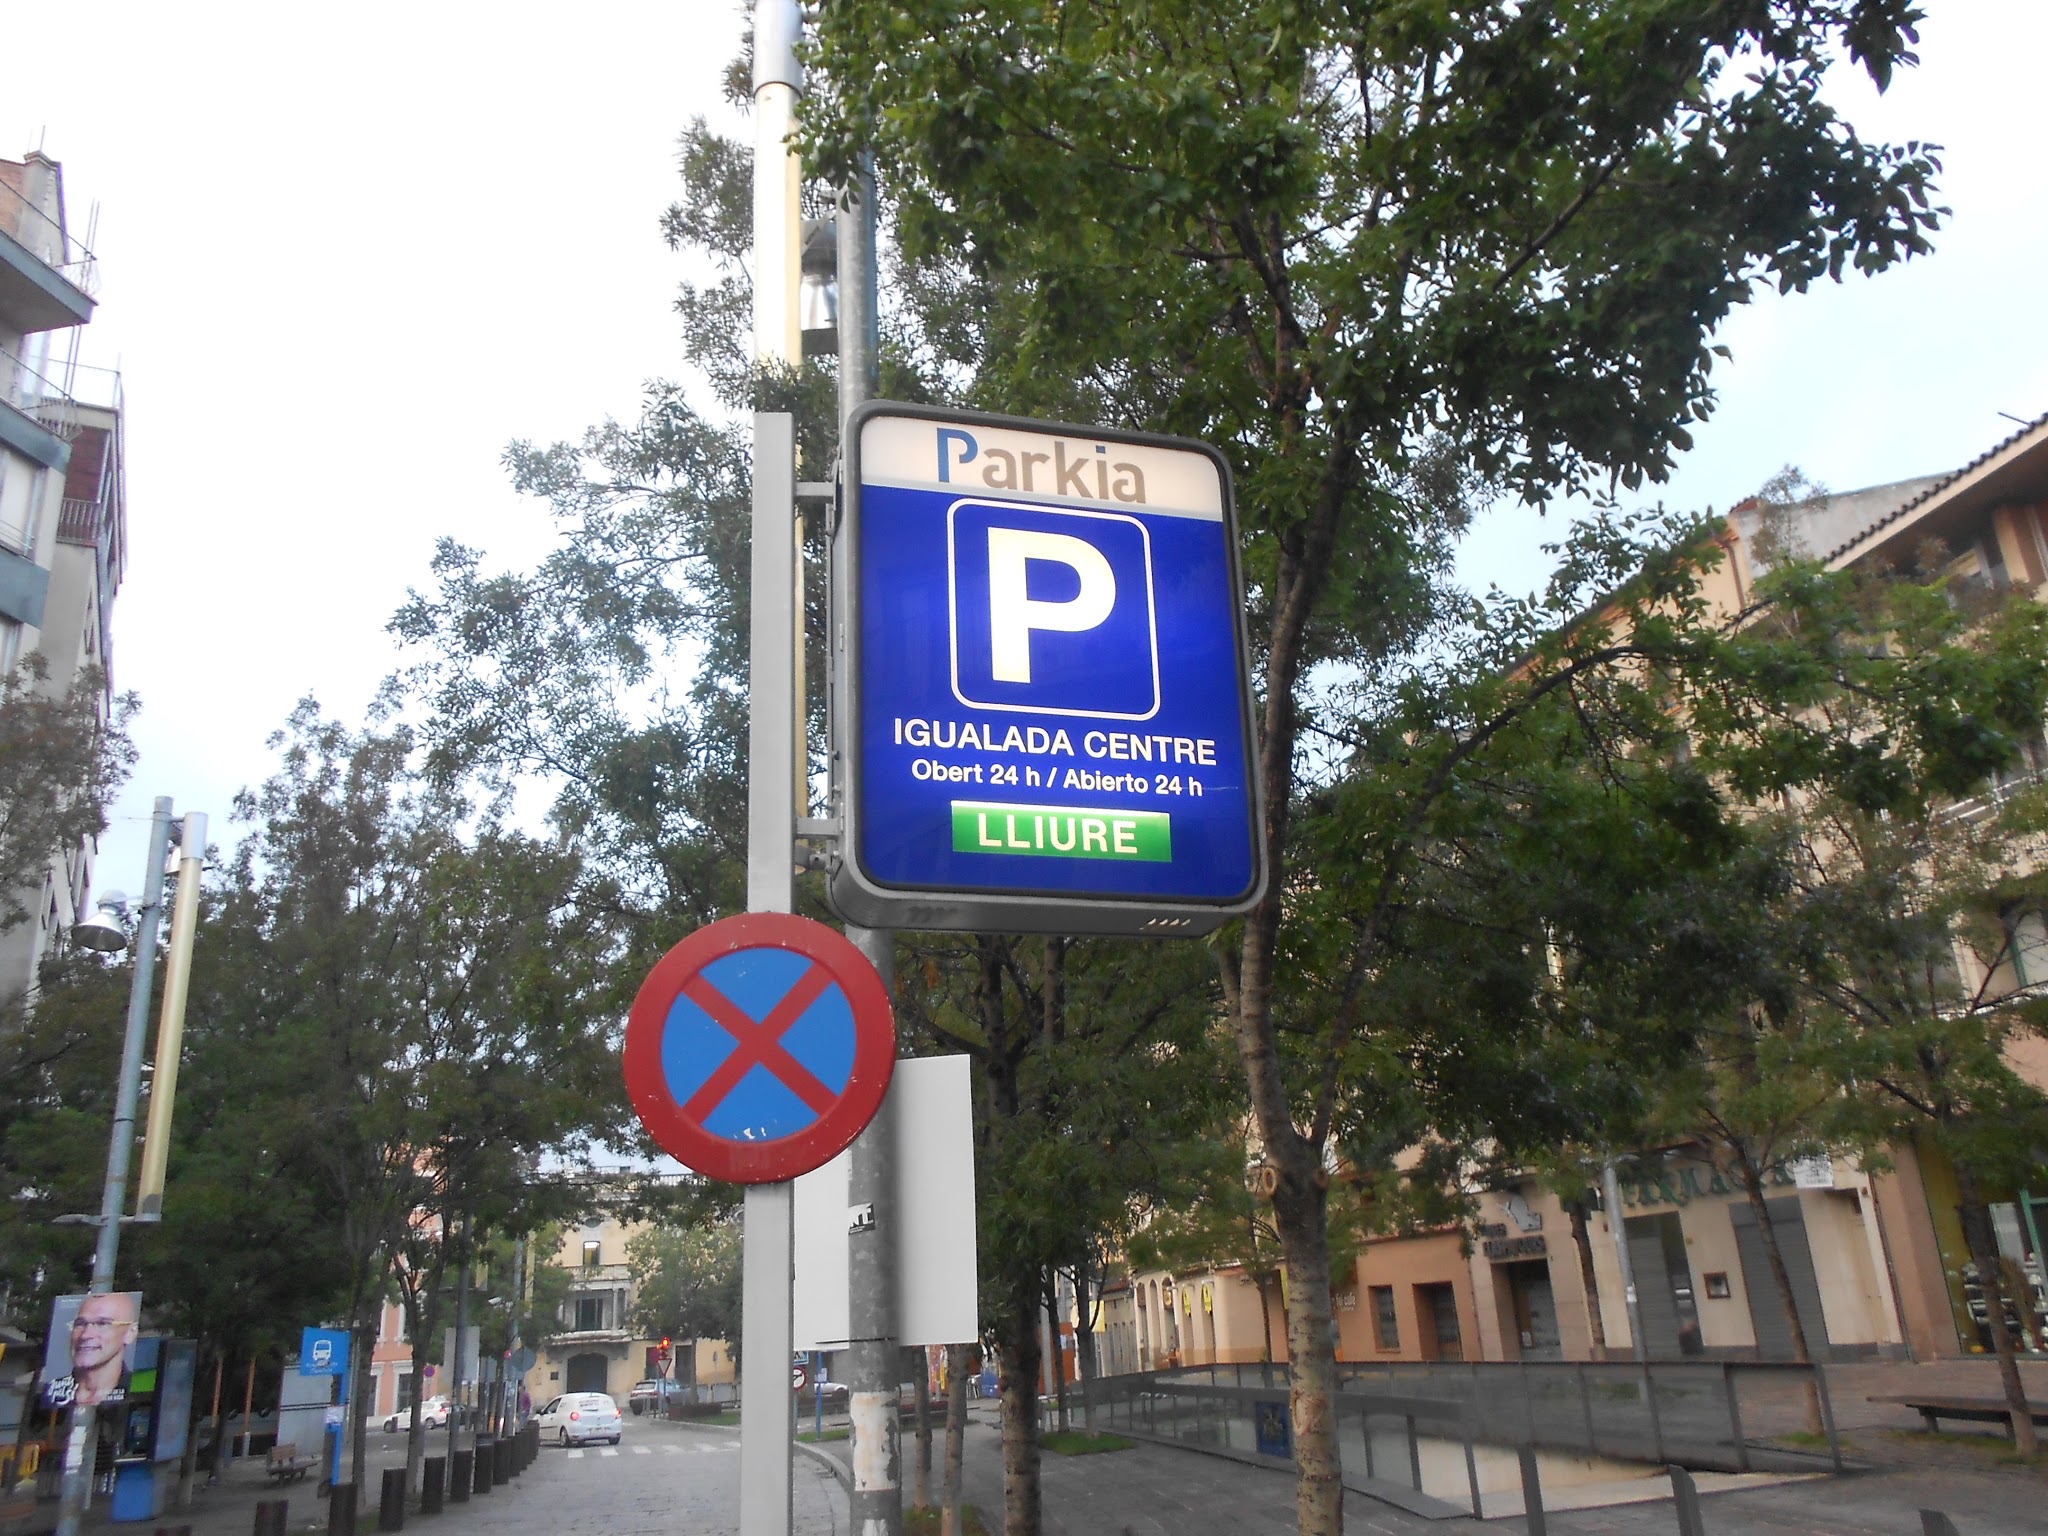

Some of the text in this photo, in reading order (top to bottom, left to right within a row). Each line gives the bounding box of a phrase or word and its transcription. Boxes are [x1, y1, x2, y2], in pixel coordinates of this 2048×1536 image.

[937, 427, 1146, 504] Parkia
[987, 526, 1117, 684] P
[894, 718, 1217, 766] IGUALADA CENTRE
[911, 758, 1203, 797] Obert 24 h / Abierto 24 h
[978, 813, 1138, 854] LLIURE
[1620, 1157, 1793, 1210] FARMACA
